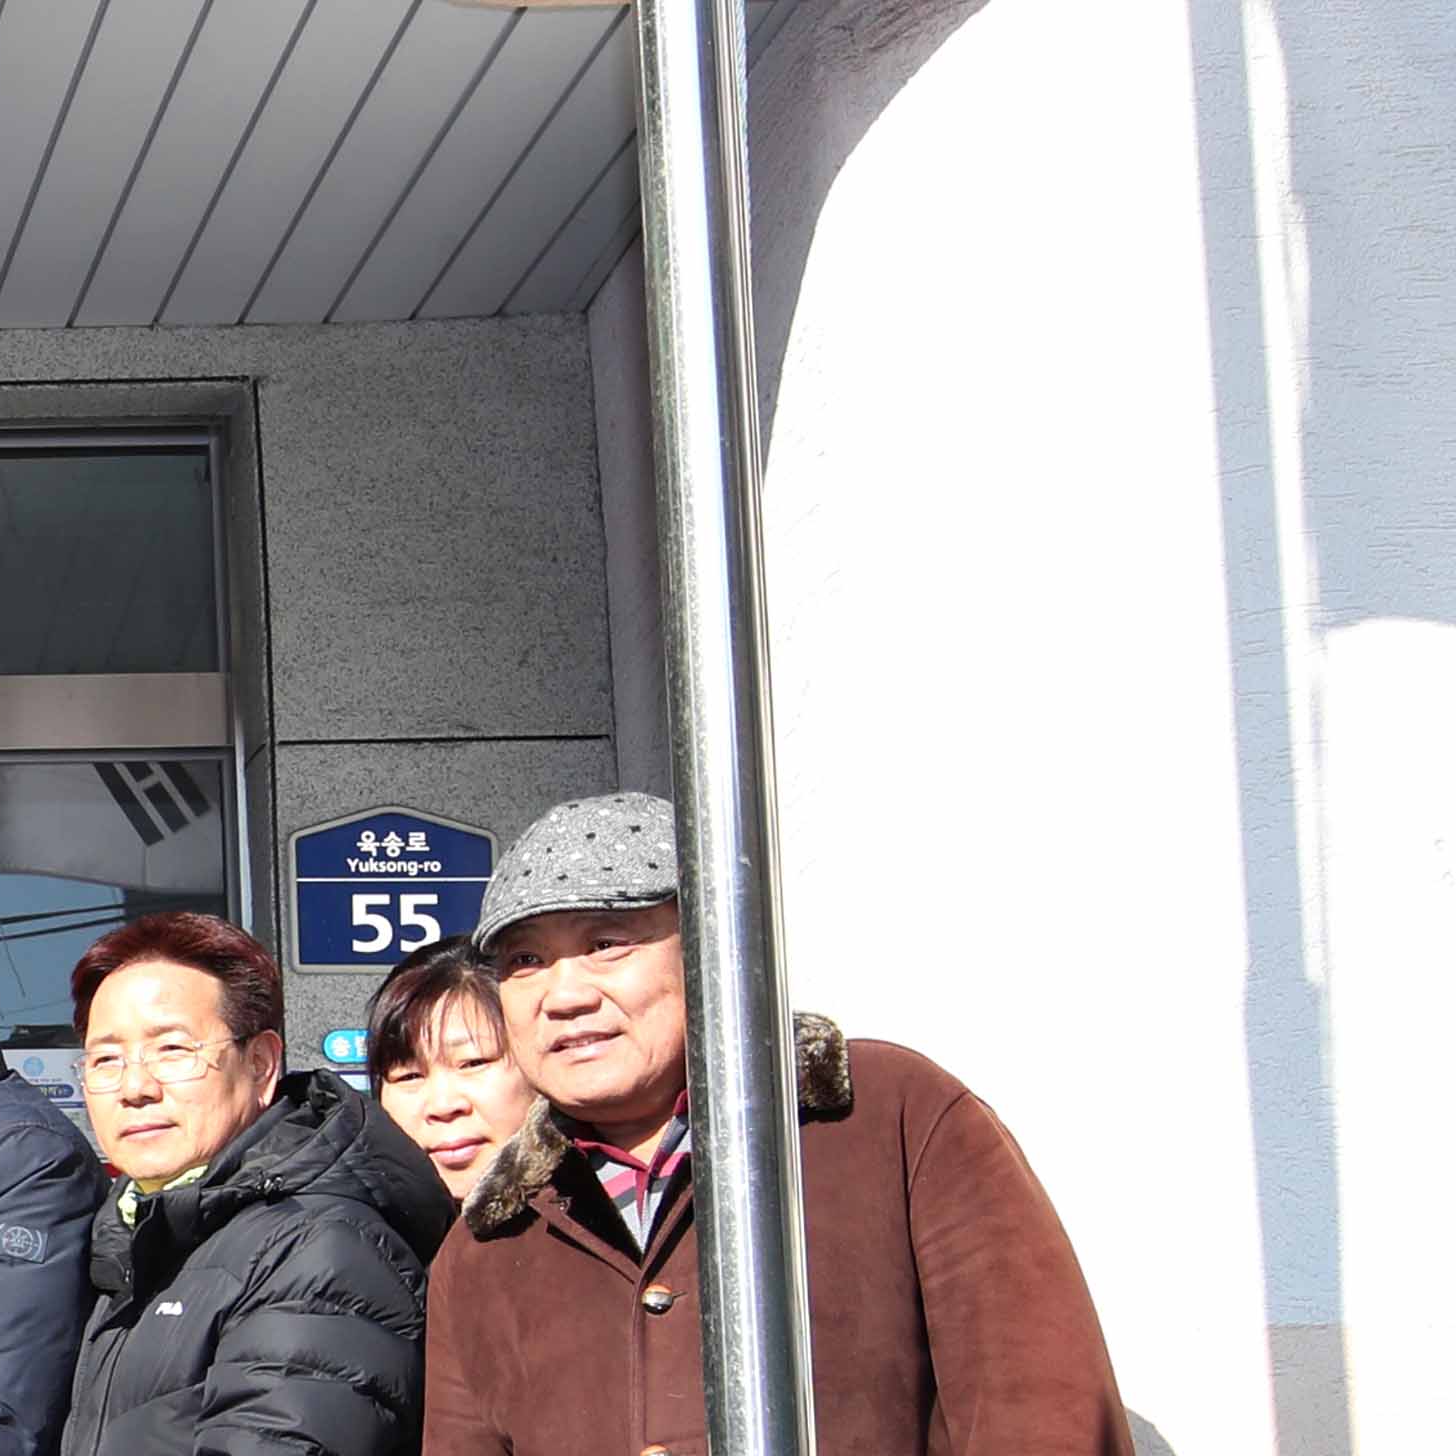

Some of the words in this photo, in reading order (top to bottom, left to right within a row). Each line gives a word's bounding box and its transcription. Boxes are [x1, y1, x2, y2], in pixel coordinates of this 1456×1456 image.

[356, 830, 431, 857] 육송로
[346, 857, 442, 877] Yuksong-ro
[351, 893, 441, 954] 55
